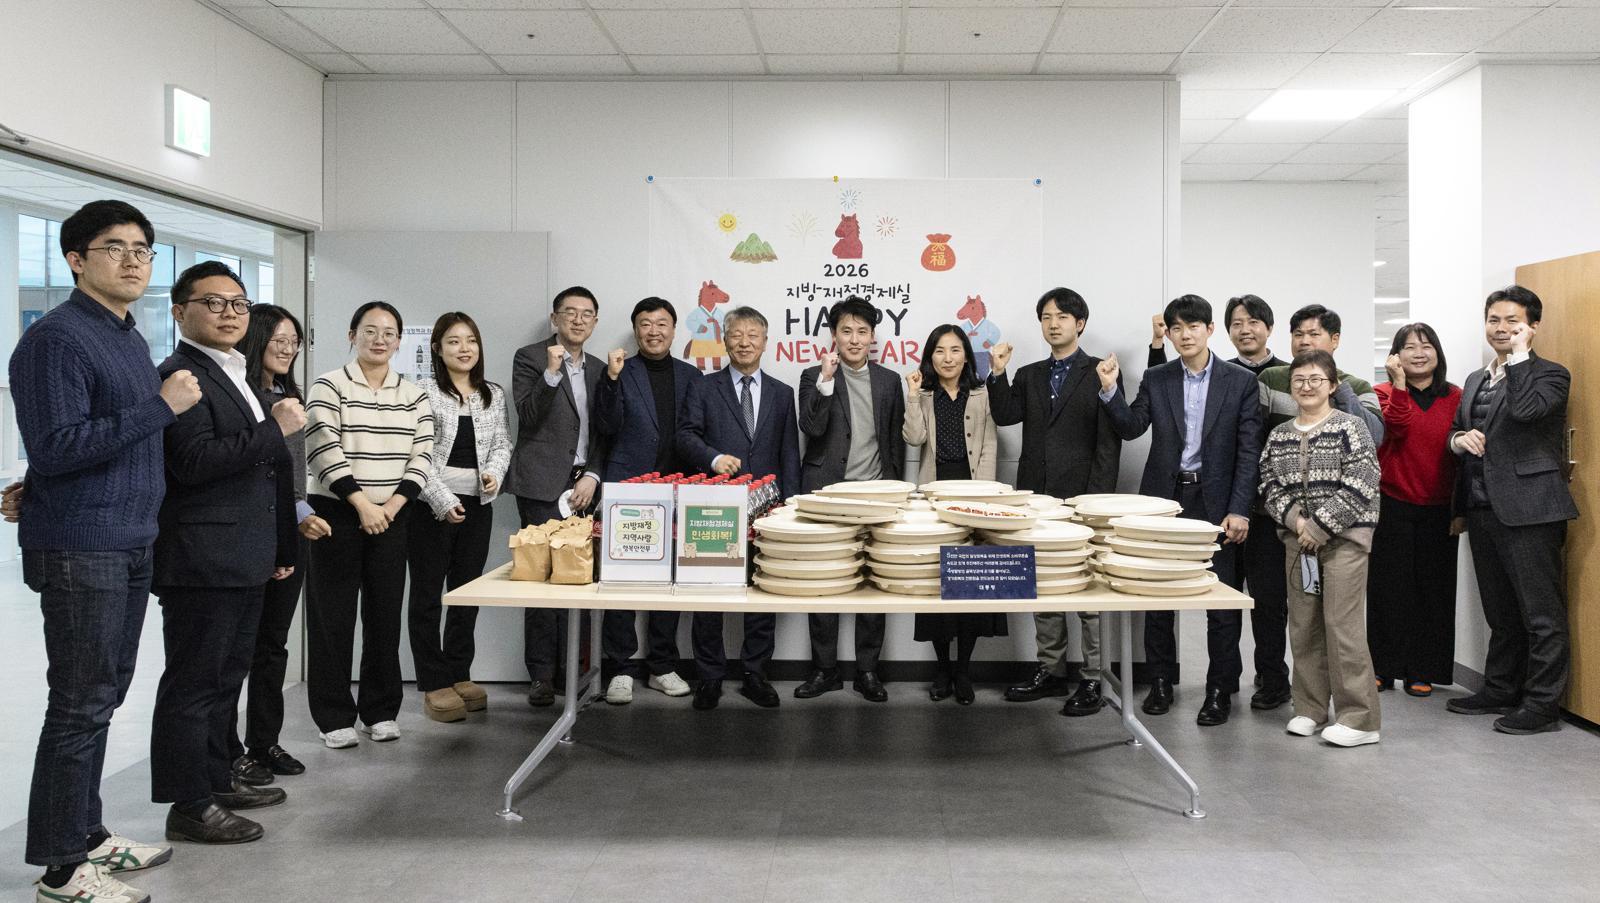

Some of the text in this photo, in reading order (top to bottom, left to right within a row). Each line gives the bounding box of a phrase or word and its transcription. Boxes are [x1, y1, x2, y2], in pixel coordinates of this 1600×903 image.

[930, 252, 946, 266] 福
[823, 263, 869, 277] 2026
[786, 282, 911, 304] 지방재정경제실
[785, 306, 908, 337] HAY
[622, 521, 652, 530] 지방재정
[622, 533, 652, 543] 지역사랑
